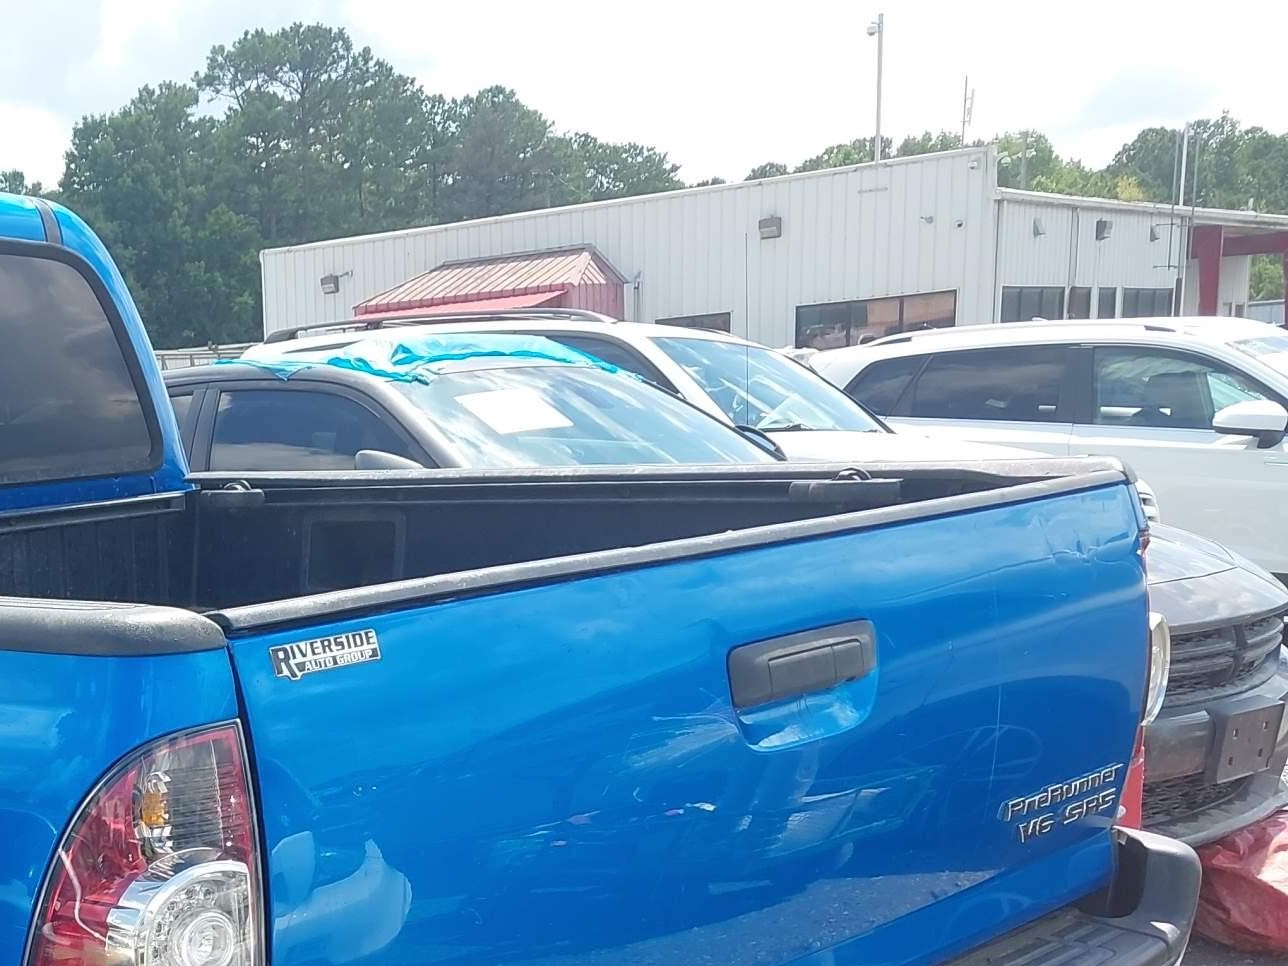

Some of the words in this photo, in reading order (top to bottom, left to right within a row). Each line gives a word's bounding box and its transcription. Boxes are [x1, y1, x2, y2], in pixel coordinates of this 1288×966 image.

[271, 630, 376, 678] RIVERSIDE
[304, 656, 333, 672] AUTO
[336, 649, 373, 666] GROUP
[1017, 812, 1055, 843] V6
[1063, 787, 1116, 825] SR5
